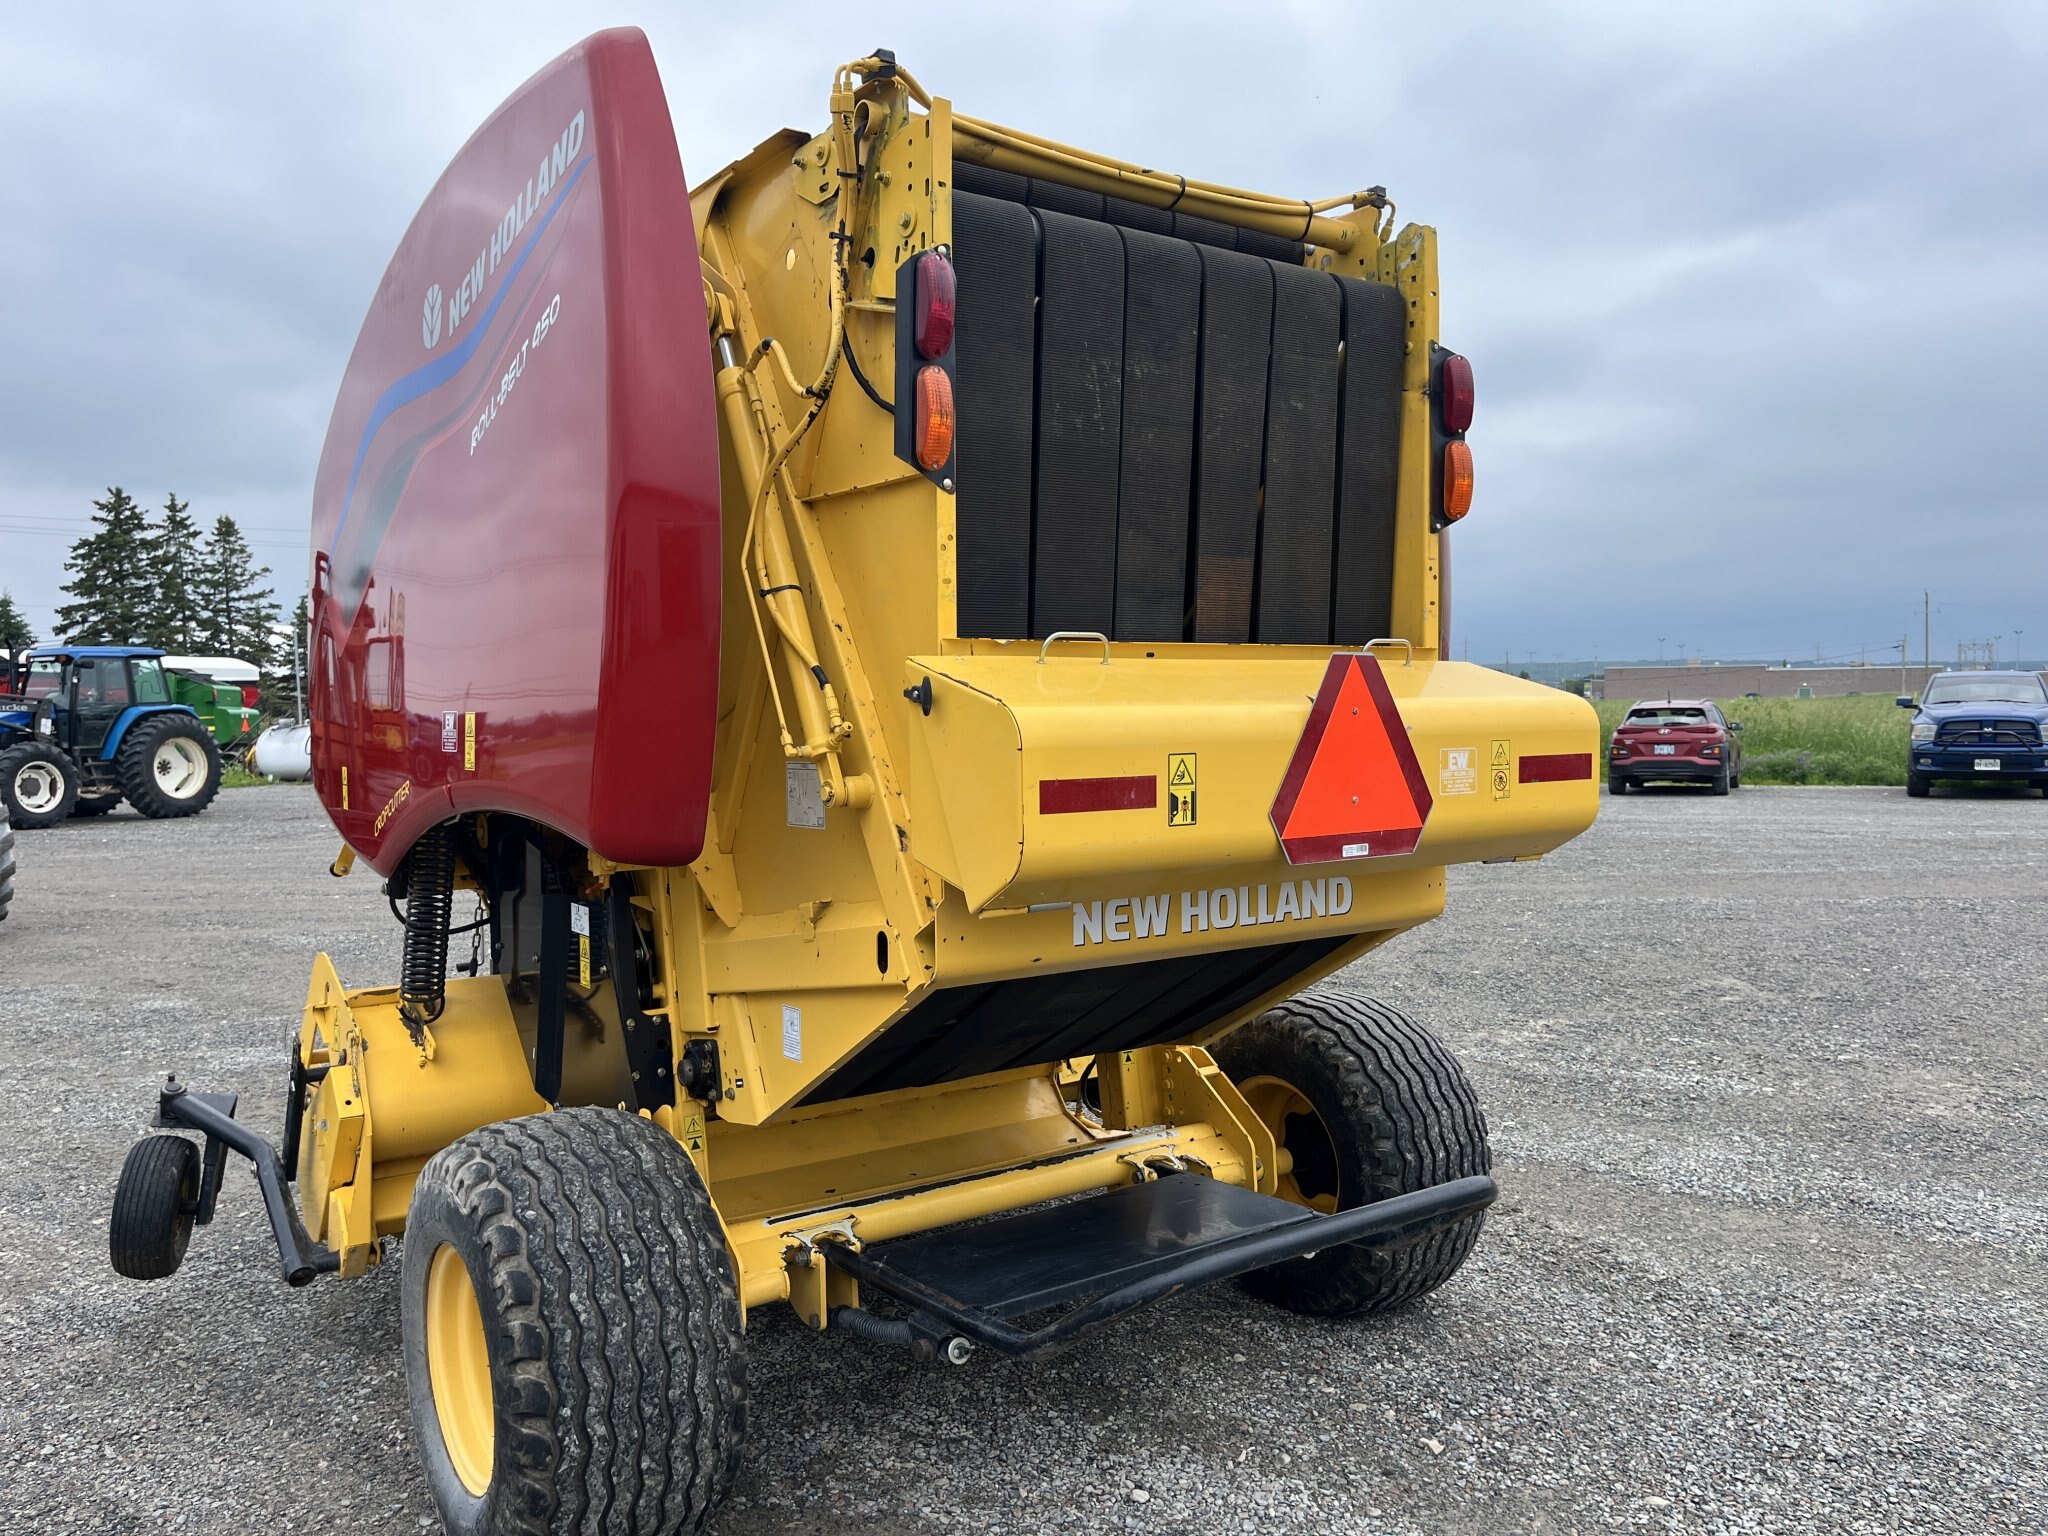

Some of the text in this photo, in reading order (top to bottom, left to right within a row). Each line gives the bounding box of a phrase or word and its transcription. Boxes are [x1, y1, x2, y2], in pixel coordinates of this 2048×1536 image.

[448, 109, 585, 337] NEW HOLLAND
[470, 339, 529, 456] ROLL-BELT
[0, 703, 28, 712] icke
[374, 780, 410, 838] CROPCUTTER
[1072, 876, 1354, 946] NEW HOLLAND
